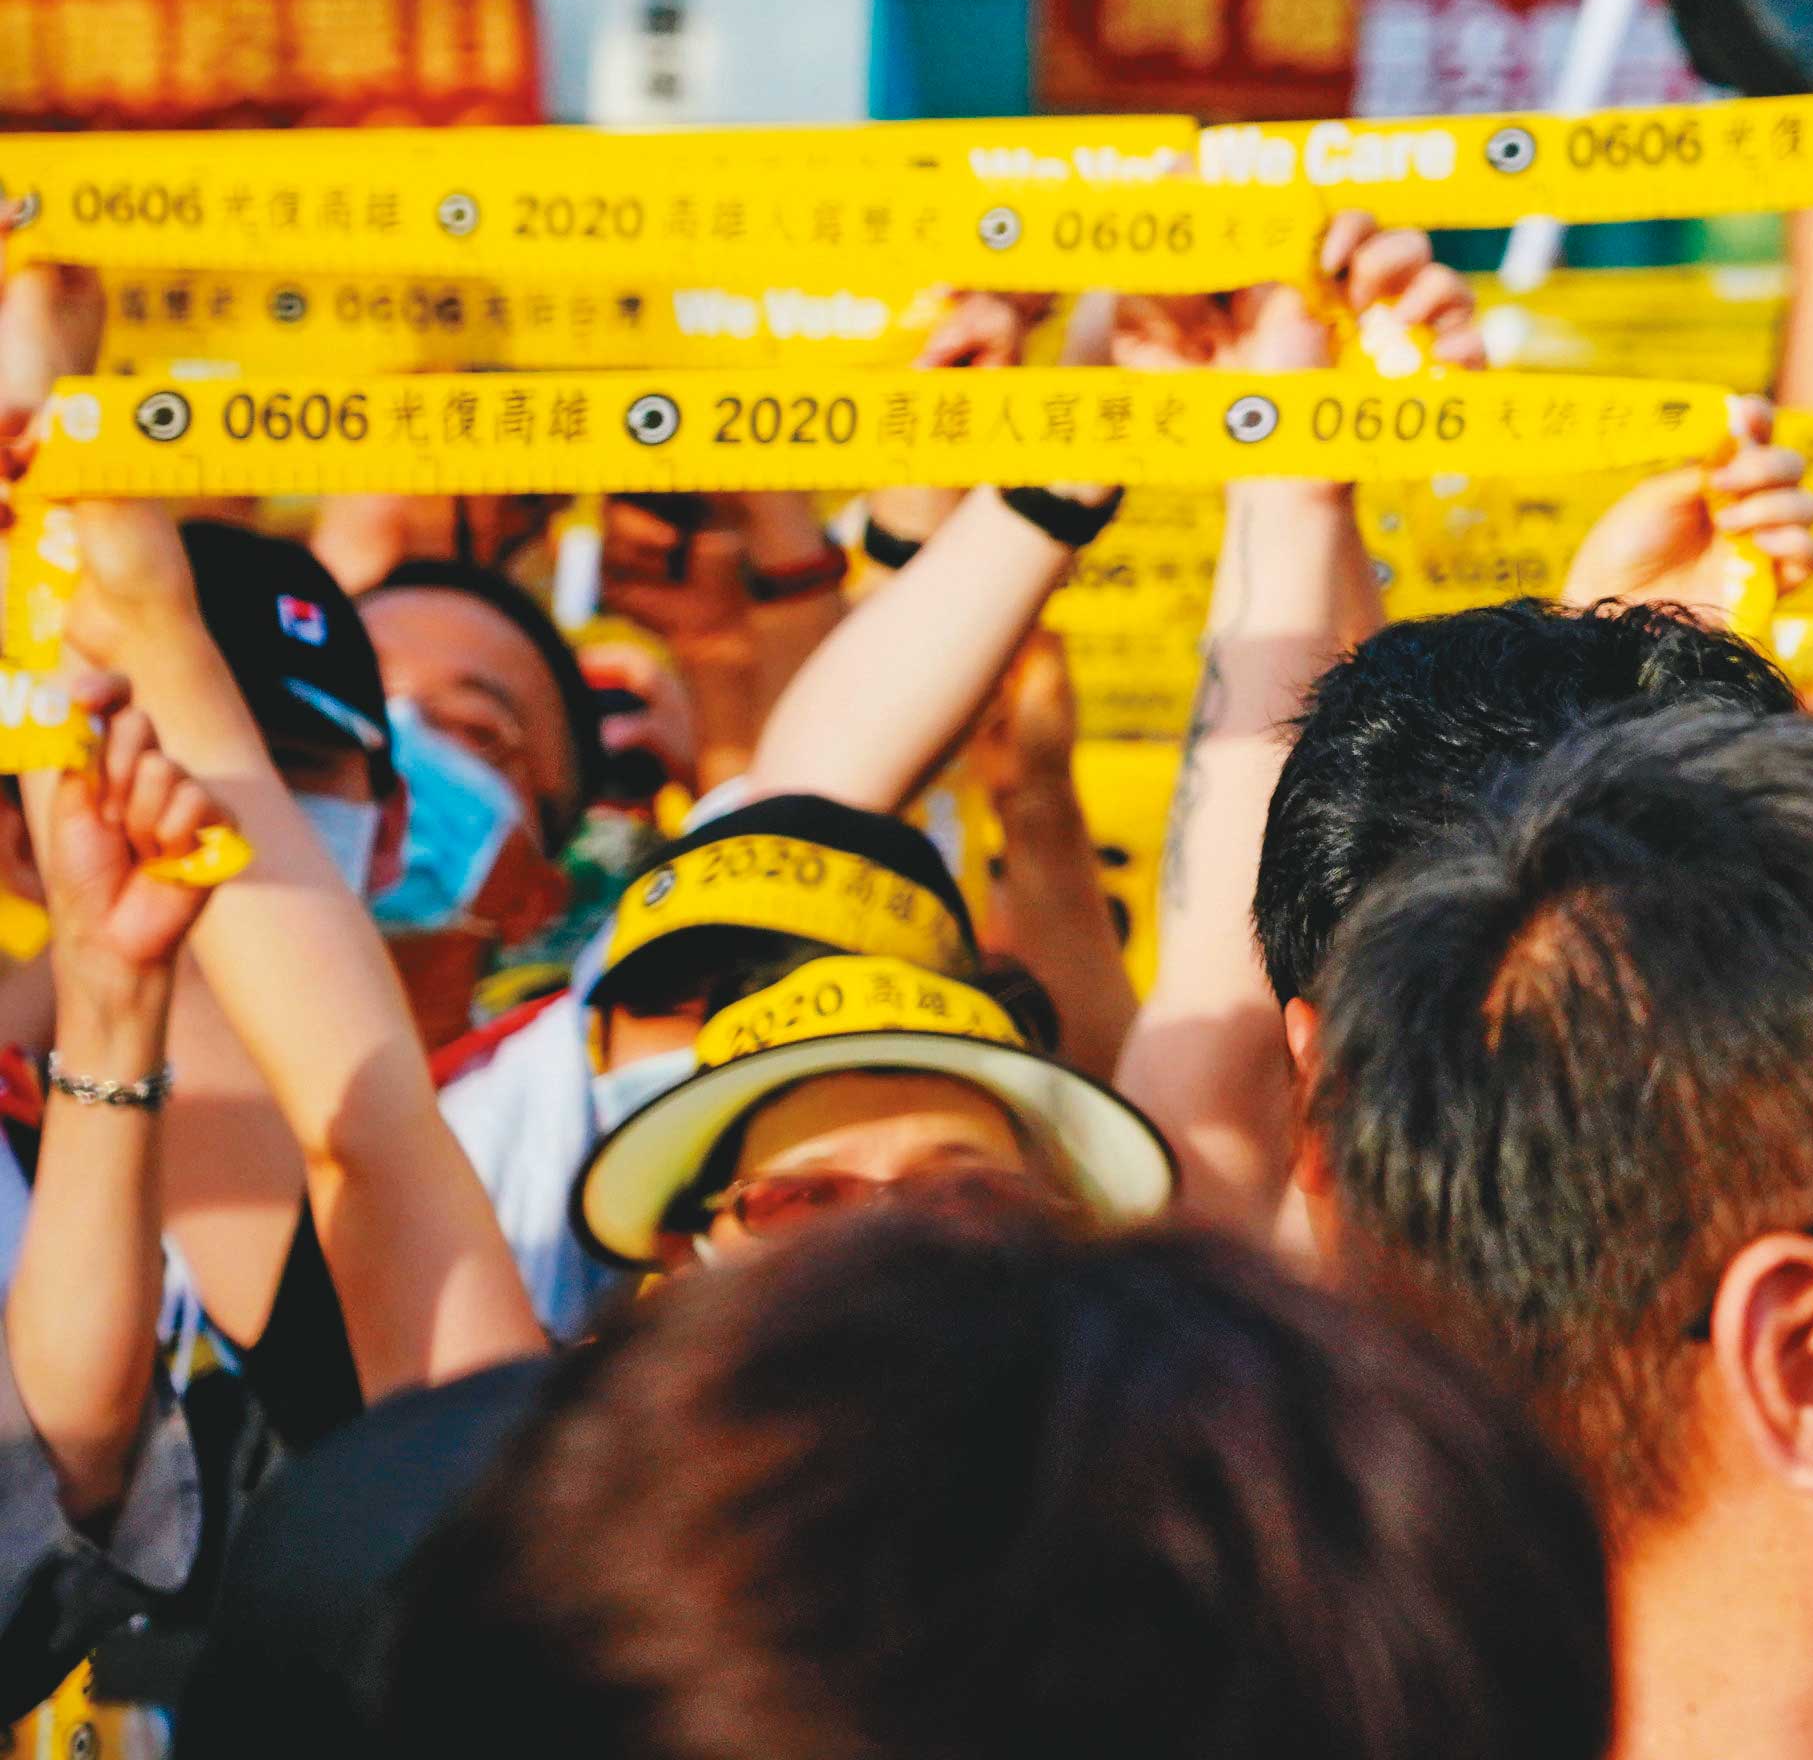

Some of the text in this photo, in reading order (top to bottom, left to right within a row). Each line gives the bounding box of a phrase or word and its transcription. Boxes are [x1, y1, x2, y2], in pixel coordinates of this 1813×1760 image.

[1198, 125, 1297, 186] We
[1303, 120, 1458, 186] Care
[1566, 123, 1704, 170] 0606
[72, 184, 204, 226] 0606
[513, 195, 645, 240] 2020
[1052, 212, 1197, 255] 0606
[223, 392, 369, 441] 0606
[386, 390, 592, 442] 光復高雄
[712, 395, 857, 444] 2020
[1311, 396, 1467, 442] 0606
